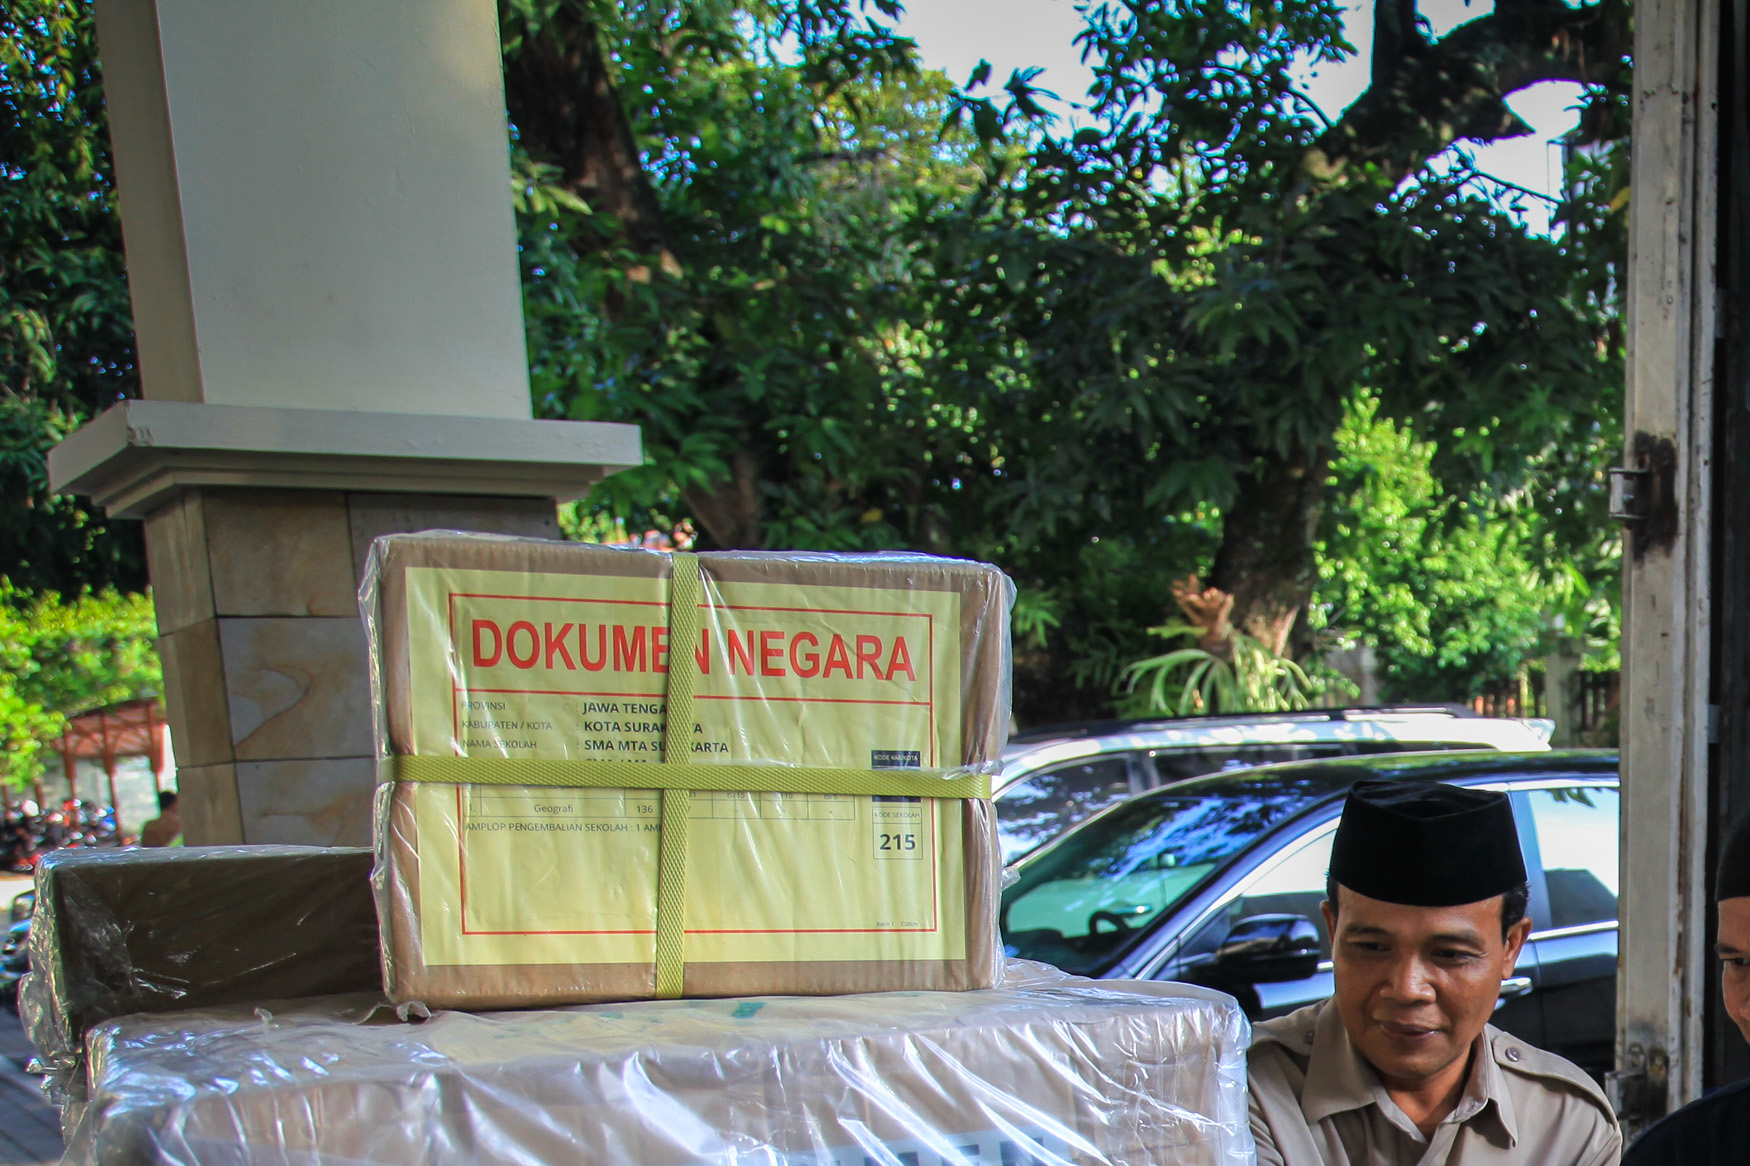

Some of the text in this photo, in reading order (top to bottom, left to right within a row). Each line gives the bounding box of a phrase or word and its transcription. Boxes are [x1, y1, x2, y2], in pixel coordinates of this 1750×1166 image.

[728, 628, 917, 682] NEGARA
[462, 701, 506, 711] PROVINSI
[582, 702, 668, 715] JAWA TENGA
[462, 720, 518, 730] KABUPATEN
[527, 721, 553, 730] KOTA
[584, 721, 621, 733] KOTA
[463, 739, 537, 749] NAMA SEKOLAH
[584, 740, 615, 751] SMA
[618, 740, 647, 752] MTA
[534, 803, 574, 815] Geografi
[637, 804, 654, 814] 136
[465, 822, 506, 832] AMPLOP
[509, 823, 583, 832] PENGEMBALIAN
[586, 823, 628, 832] SEKOLAH
[879, 833, 916, 851] 215
